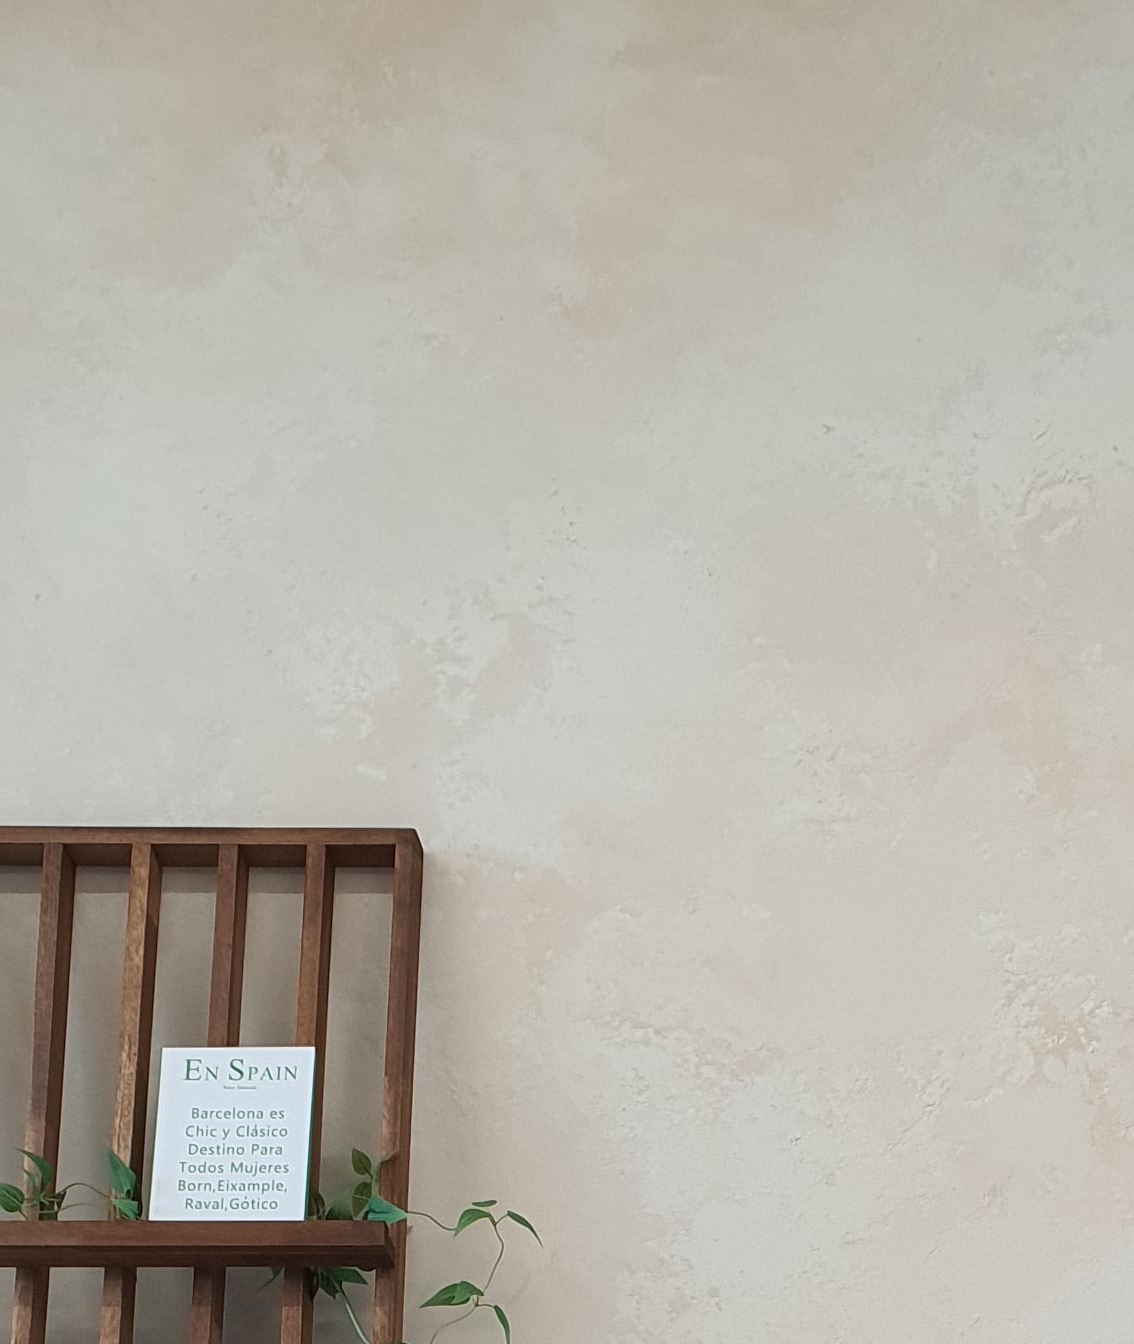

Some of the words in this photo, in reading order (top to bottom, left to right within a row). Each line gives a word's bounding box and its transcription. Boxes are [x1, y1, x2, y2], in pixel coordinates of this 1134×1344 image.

[191, 1107, 264, 1119] Barcelona
[269, 1110, 285, 1119] es
[185, 1125, 217, 1138] Chic
[222, 1128, 230, 1140] y
[236, 1124, 288, 1138] Clásico
[188, 1143, 245, 1155] Destino
[251, 1143, 283, 1155] Para
[179, 1161, 224, 1174] Todos
[230, 1161, 290, 1177] Mujeres
